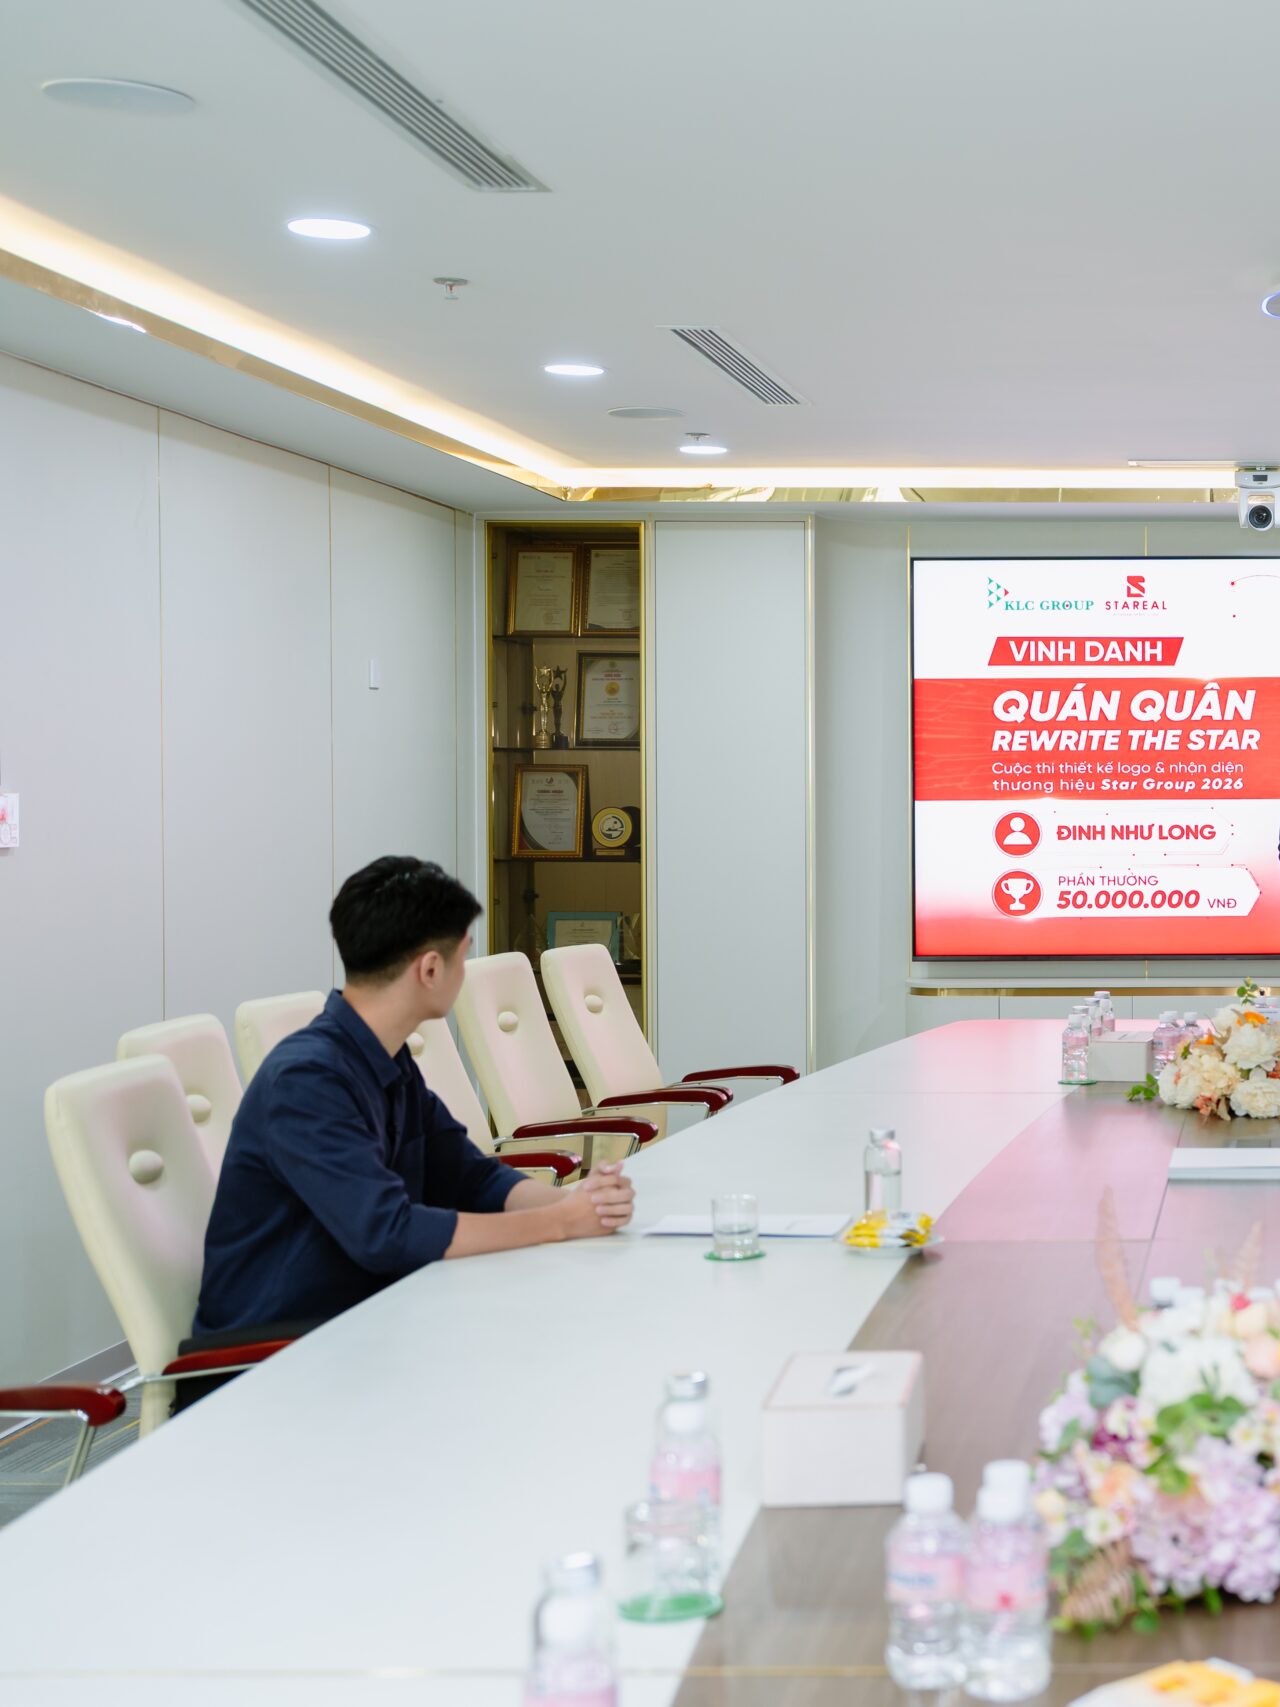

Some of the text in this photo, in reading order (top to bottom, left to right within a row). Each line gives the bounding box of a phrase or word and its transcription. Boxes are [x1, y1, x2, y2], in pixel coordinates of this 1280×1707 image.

[1004, 600, 1094, 611] KLC GROUP
[1105, 600, 1167, 611] STAREAL
[1008, 640, 1163, 662] VINH DANH
[992, 682, 1257, 723] QUÁN QUÂN
[991, 729, 1261, 751] REWRITE THE STAR
[991, 761, 1244, 777] Cuộc thi thiết kế logo & nhận diện
[992, 778, 1244, 794] thương hiệu Star Group 2026
[1056, 823, 1217, 841] ĐINH NHƯ LONG
[1056, 889, 1237, 910] 50.000.000 VNĐ
